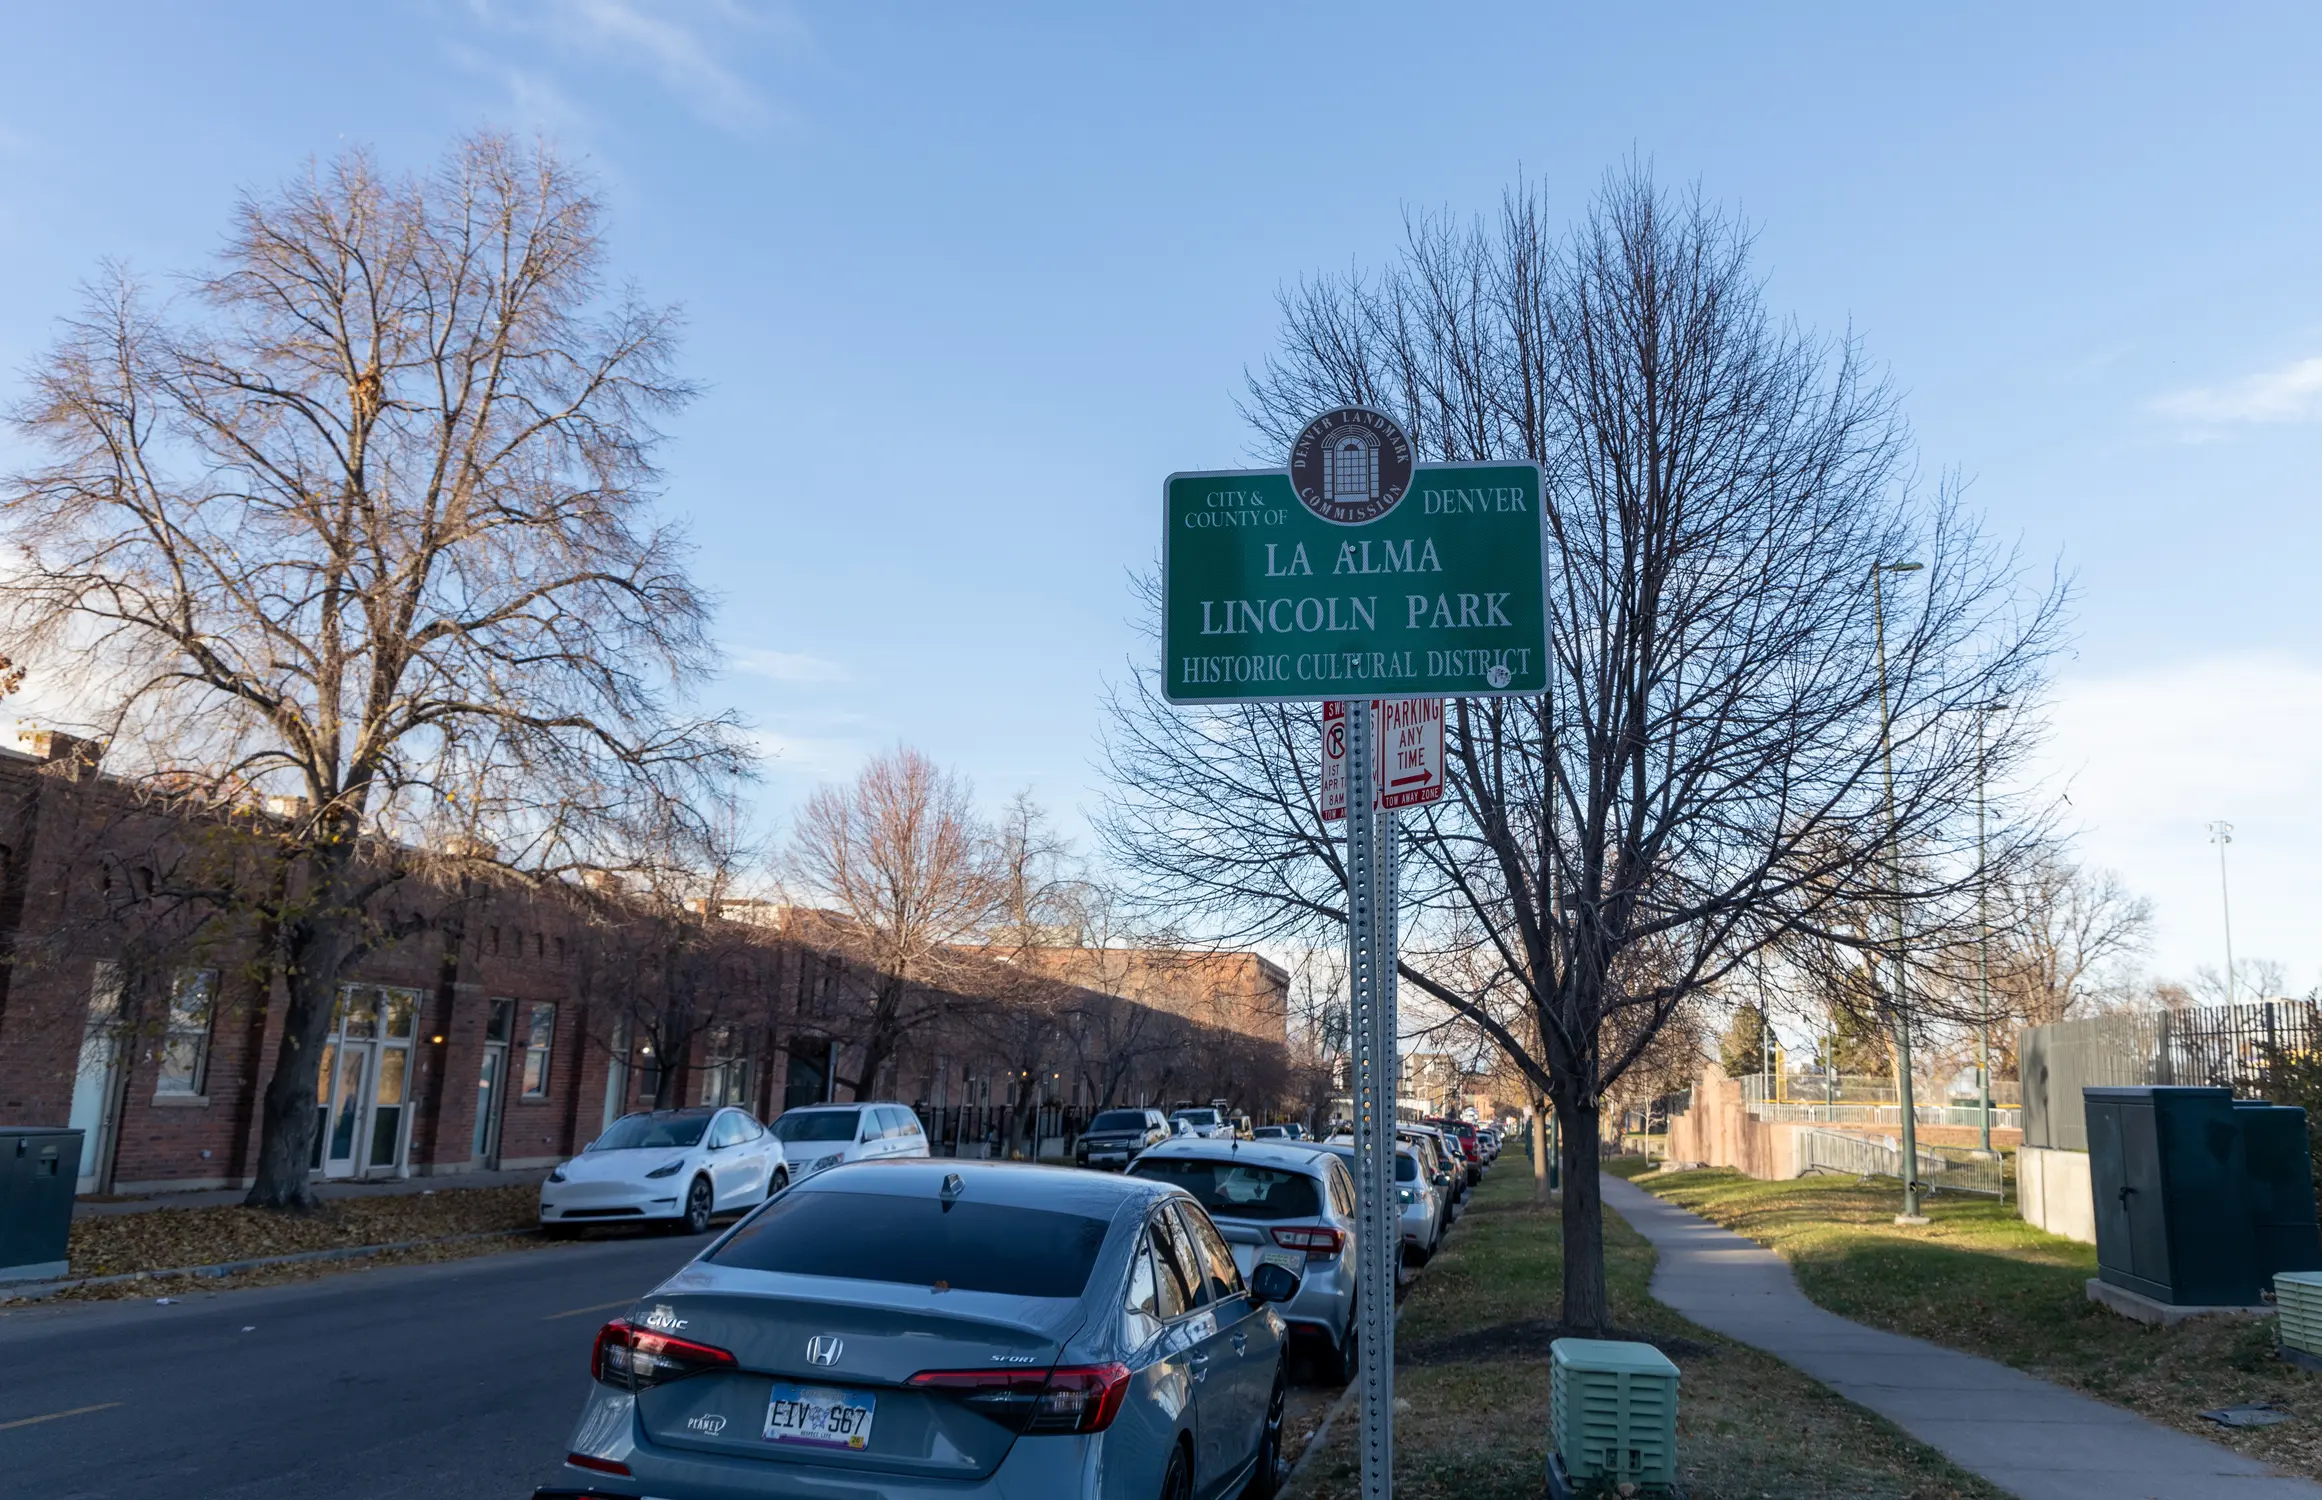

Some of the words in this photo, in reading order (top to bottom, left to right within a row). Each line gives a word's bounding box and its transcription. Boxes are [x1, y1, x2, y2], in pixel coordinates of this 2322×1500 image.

[1294, 417, 1333, 468] DENVER
[1342, 411, 1409, 464] LANDMARK
[1207, 492, 1247, 507] CITY
[1250, 490, 1265, 506] &
[1301, 484, 1402, 520] COMMISSION
[1423, 487, 1527, 515] DENVER
[1185, 510, 1260, 528] COUNTY
[1264, 509, 1287, 526] OF
[1264, 541, 1313, 577] LA
[1332, 537, 1442, 575] ALMA
[1200, 596, 1377, 635] LINCOLN
[1405, 592, 1512, 629] PARK
[1182, 654, 1291, 683] HISTORIC
[1296, 651, 1417, 681] CULTURAL
[1427, 648, 1531, 678] DISTRICT
[1387, 699, 1439, 731] PARKING
[1399, 725, 1425, 748] ANY
[1397, 747, 1425, 770] TIME
[1324, 778, 1338, 792] APR
[1386, 795, 1399, 807] TOW
[1401, 791, 1418, 804] AWAY
[1421, 788, 1439, 800] ZONE
[1325, 811, 1336, 820] TOW
[646, 1316, 688, 1330] CIVIC
[990, 1355, 1037, 1363] SPORT
[687, 1417, 721, 1433] PLANET
